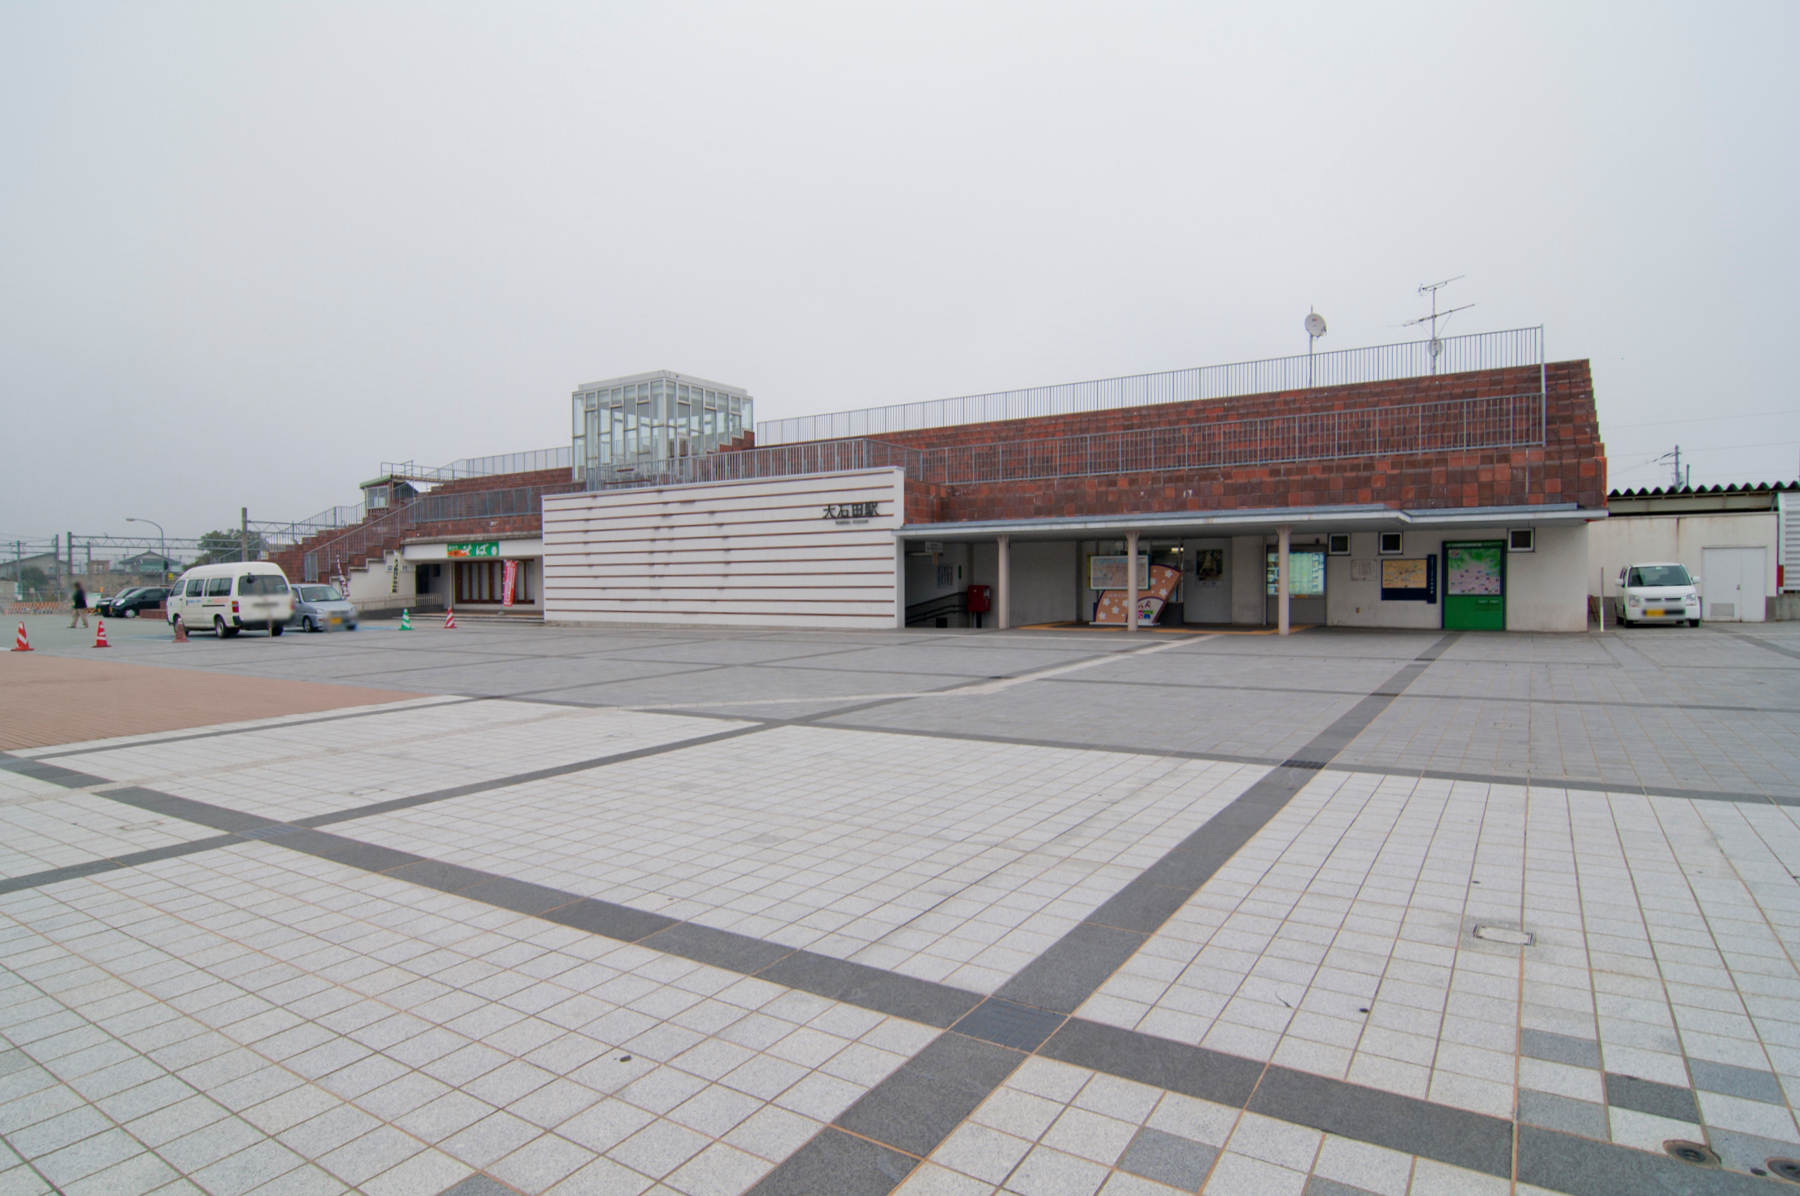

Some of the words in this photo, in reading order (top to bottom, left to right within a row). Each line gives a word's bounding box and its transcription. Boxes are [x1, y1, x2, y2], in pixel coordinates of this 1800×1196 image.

[822, 502, 880, 519] 大石田駅
[460, 543, 489, 556] そば
